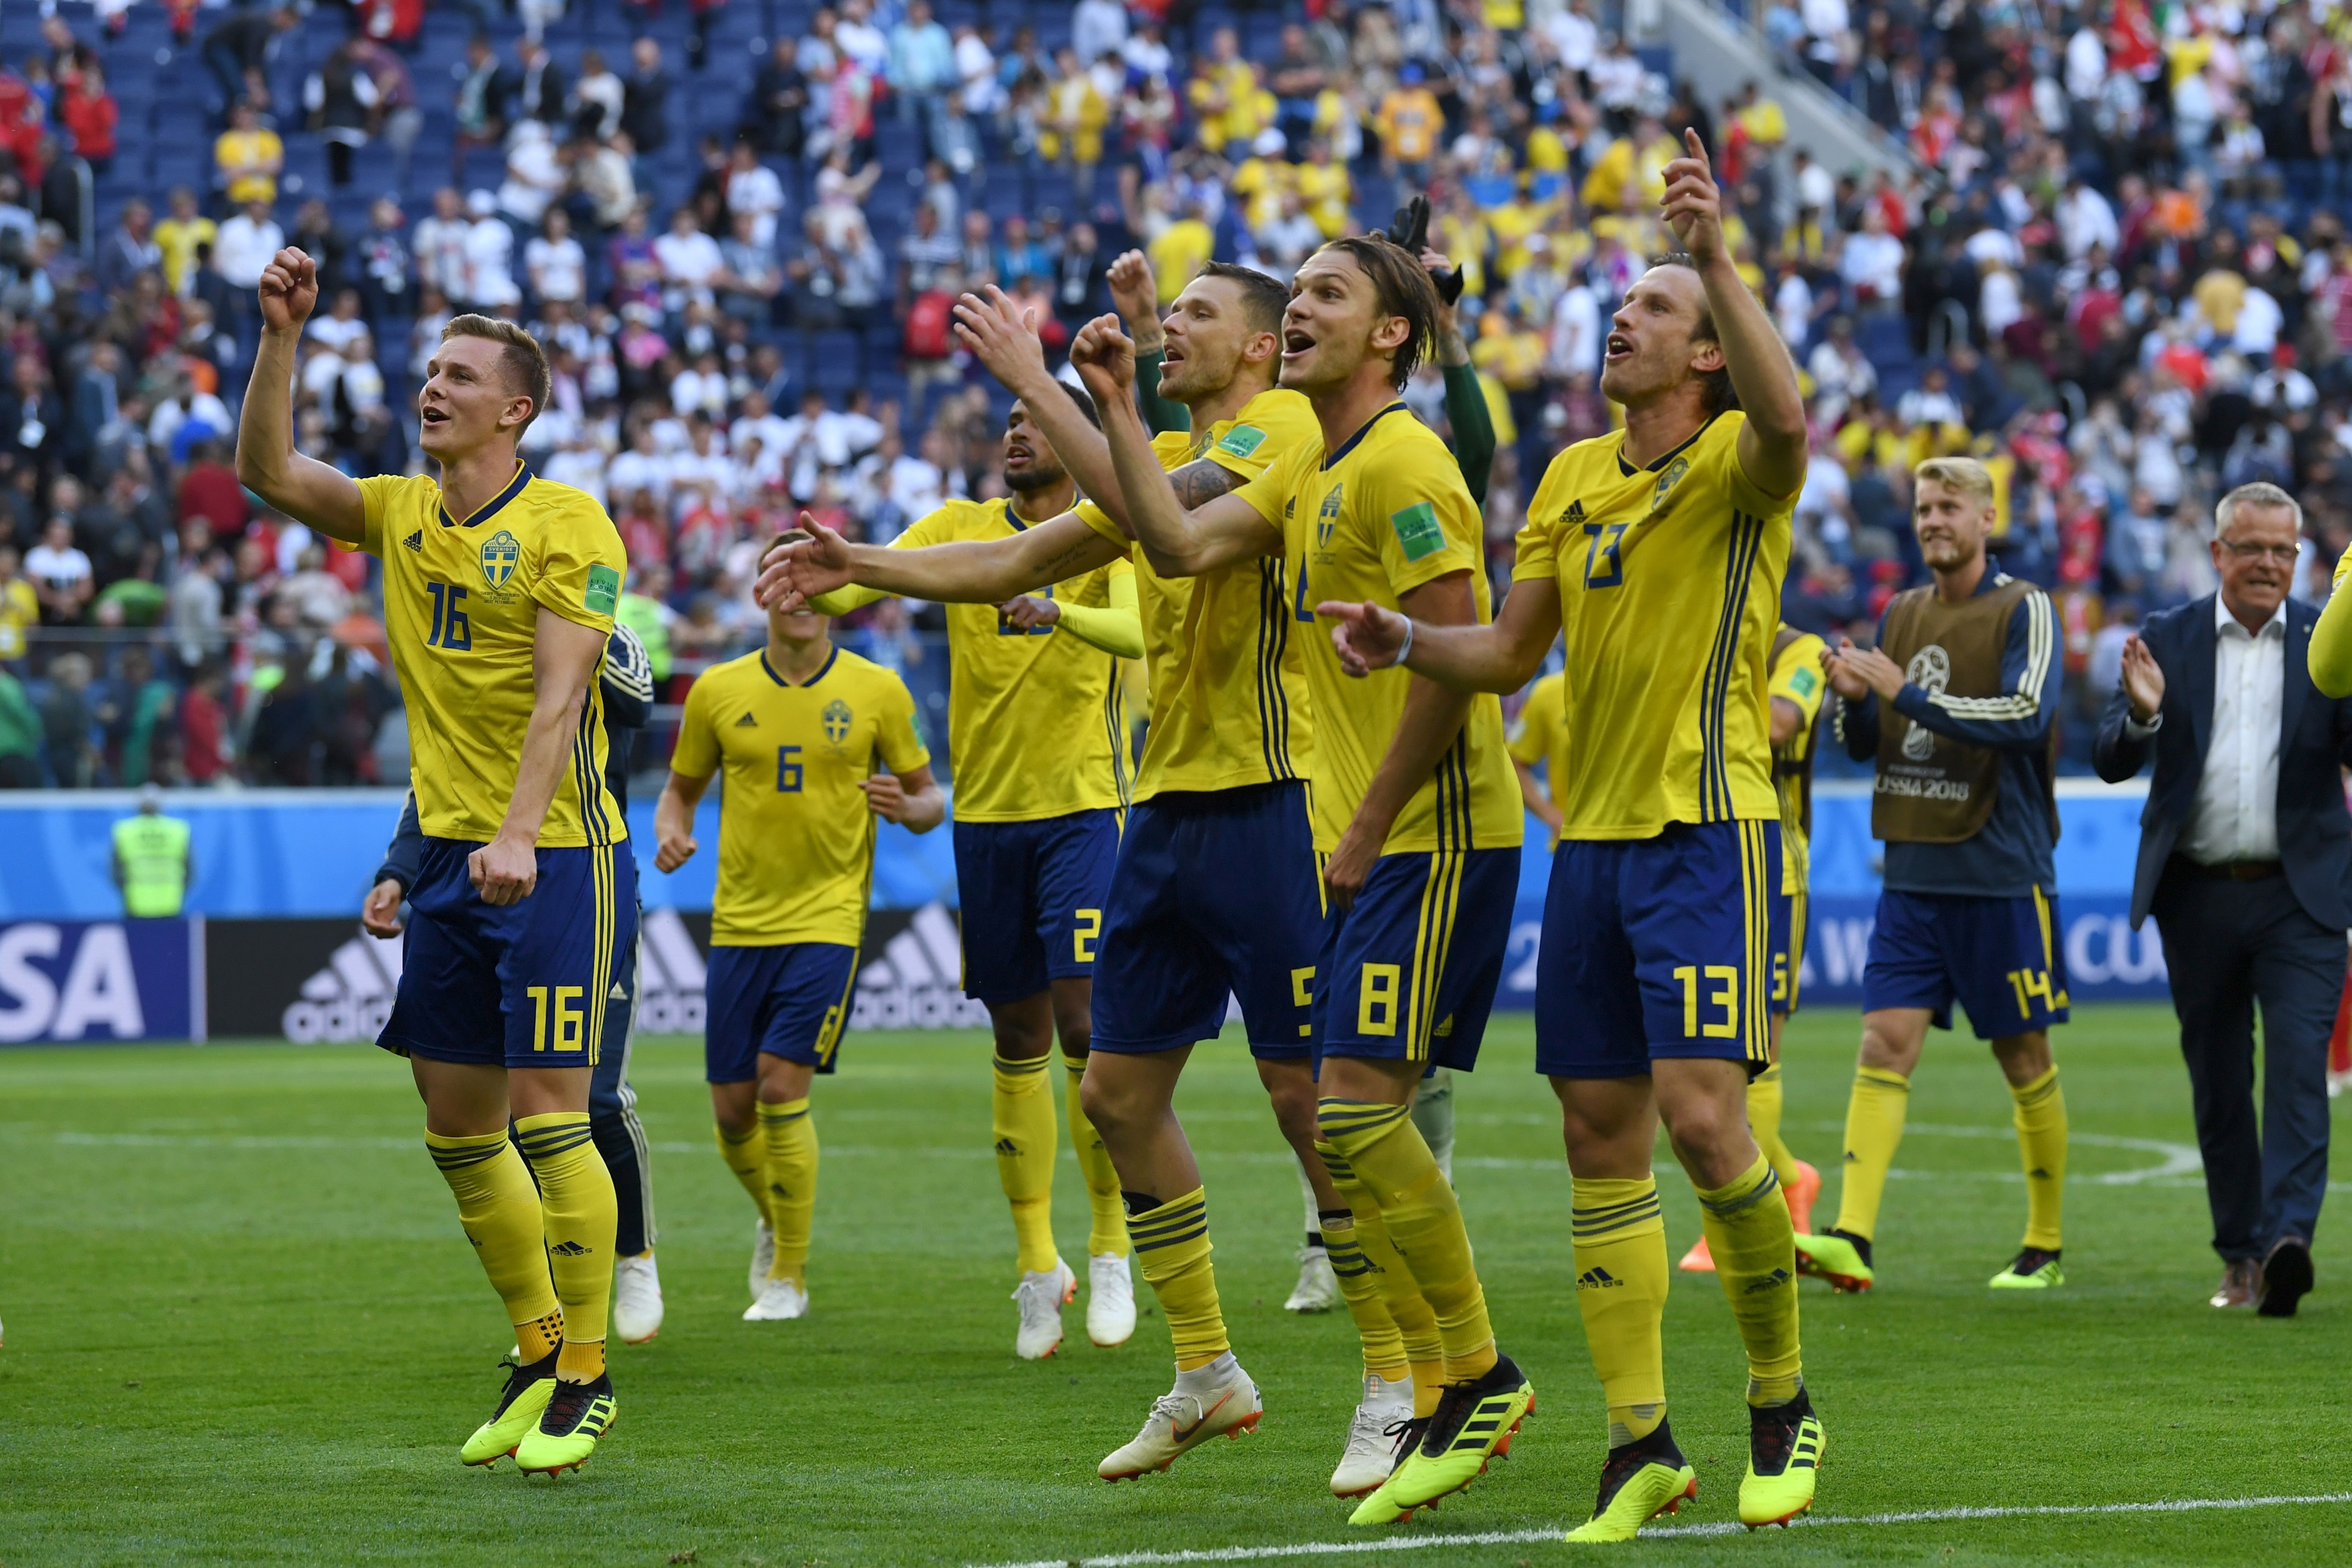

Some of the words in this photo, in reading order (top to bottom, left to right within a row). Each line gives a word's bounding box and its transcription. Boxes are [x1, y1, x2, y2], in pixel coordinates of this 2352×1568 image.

[403, 539, 422, 553] adidas
[1584, 523, 1630, 591] 13
[591, 578, 616, 590] LIVING
[427, 582, 471, 651] 16
[777, 745, 802, 792] 6
[2064, 912, 2169, 985] CU
[527, 985, 583, 1052] 16
[1358, 962, 1400, 1037] 8
[1673, 964, 1739, 1039] 13
[2006, 967, 2056, 1020] 14
[813, 1005, 838, 1054] 6
[550, 1247, 593, 1257] adidas
